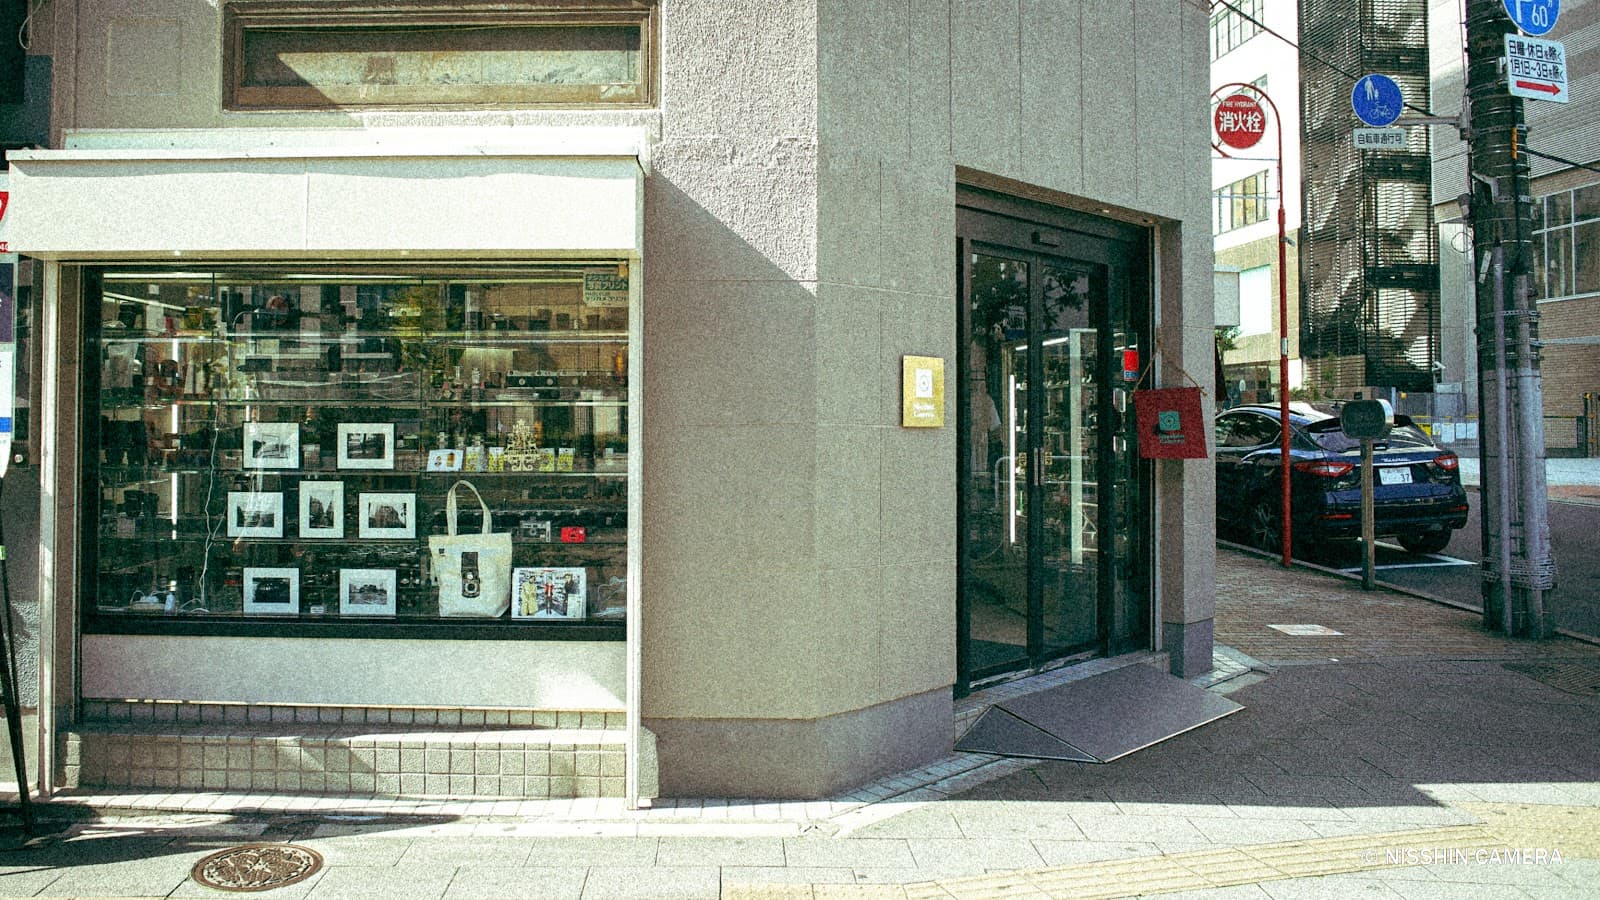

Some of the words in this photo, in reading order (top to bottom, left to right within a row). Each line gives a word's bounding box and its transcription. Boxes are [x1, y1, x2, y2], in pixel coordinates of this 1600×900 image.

[1219, 110, 1262, 132] 消火栓
[1357, 133, 1402, 145] 自転車通行可
